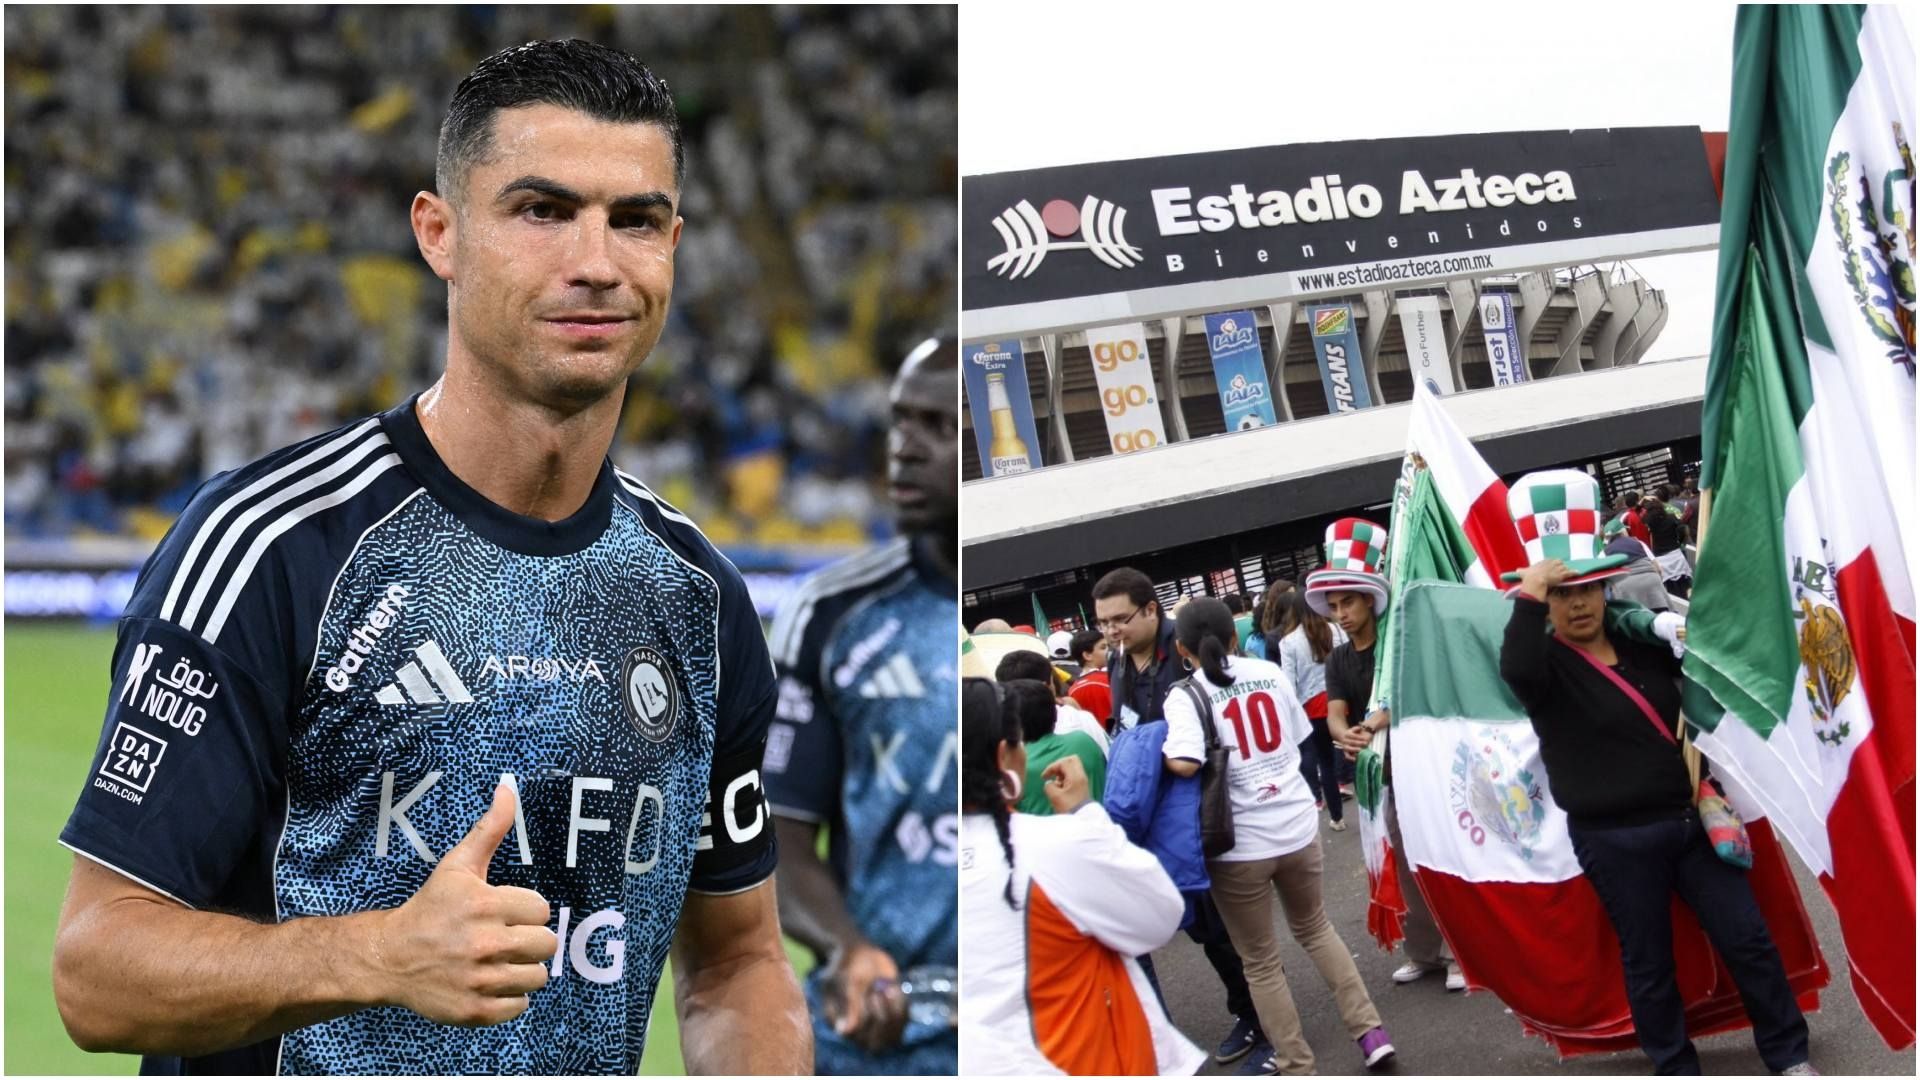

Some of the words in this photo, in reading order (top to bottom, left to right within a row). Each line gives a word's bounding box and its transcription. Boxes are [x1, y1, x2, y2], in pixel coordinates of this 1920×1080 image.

[1151, 174, 1382, 237] Estadio
[1399, 168, 1577, 215] Azteca
[1297, 252, 1494, 292] www.estadioazteca.com.mx
[1416, 309, 1428, 350] Further
[973, 352, 1012, 365] Corona
[985, 361, 1006, 370] Extra
[1325, 343, 1357, 412] FRANS
[1422, 351, 1431, 368] Go
[140, 683, 207, 736] NOUG
[1222, 691, 1281, 761] 10
[94, 777, 143, 806] DAZN.COM
